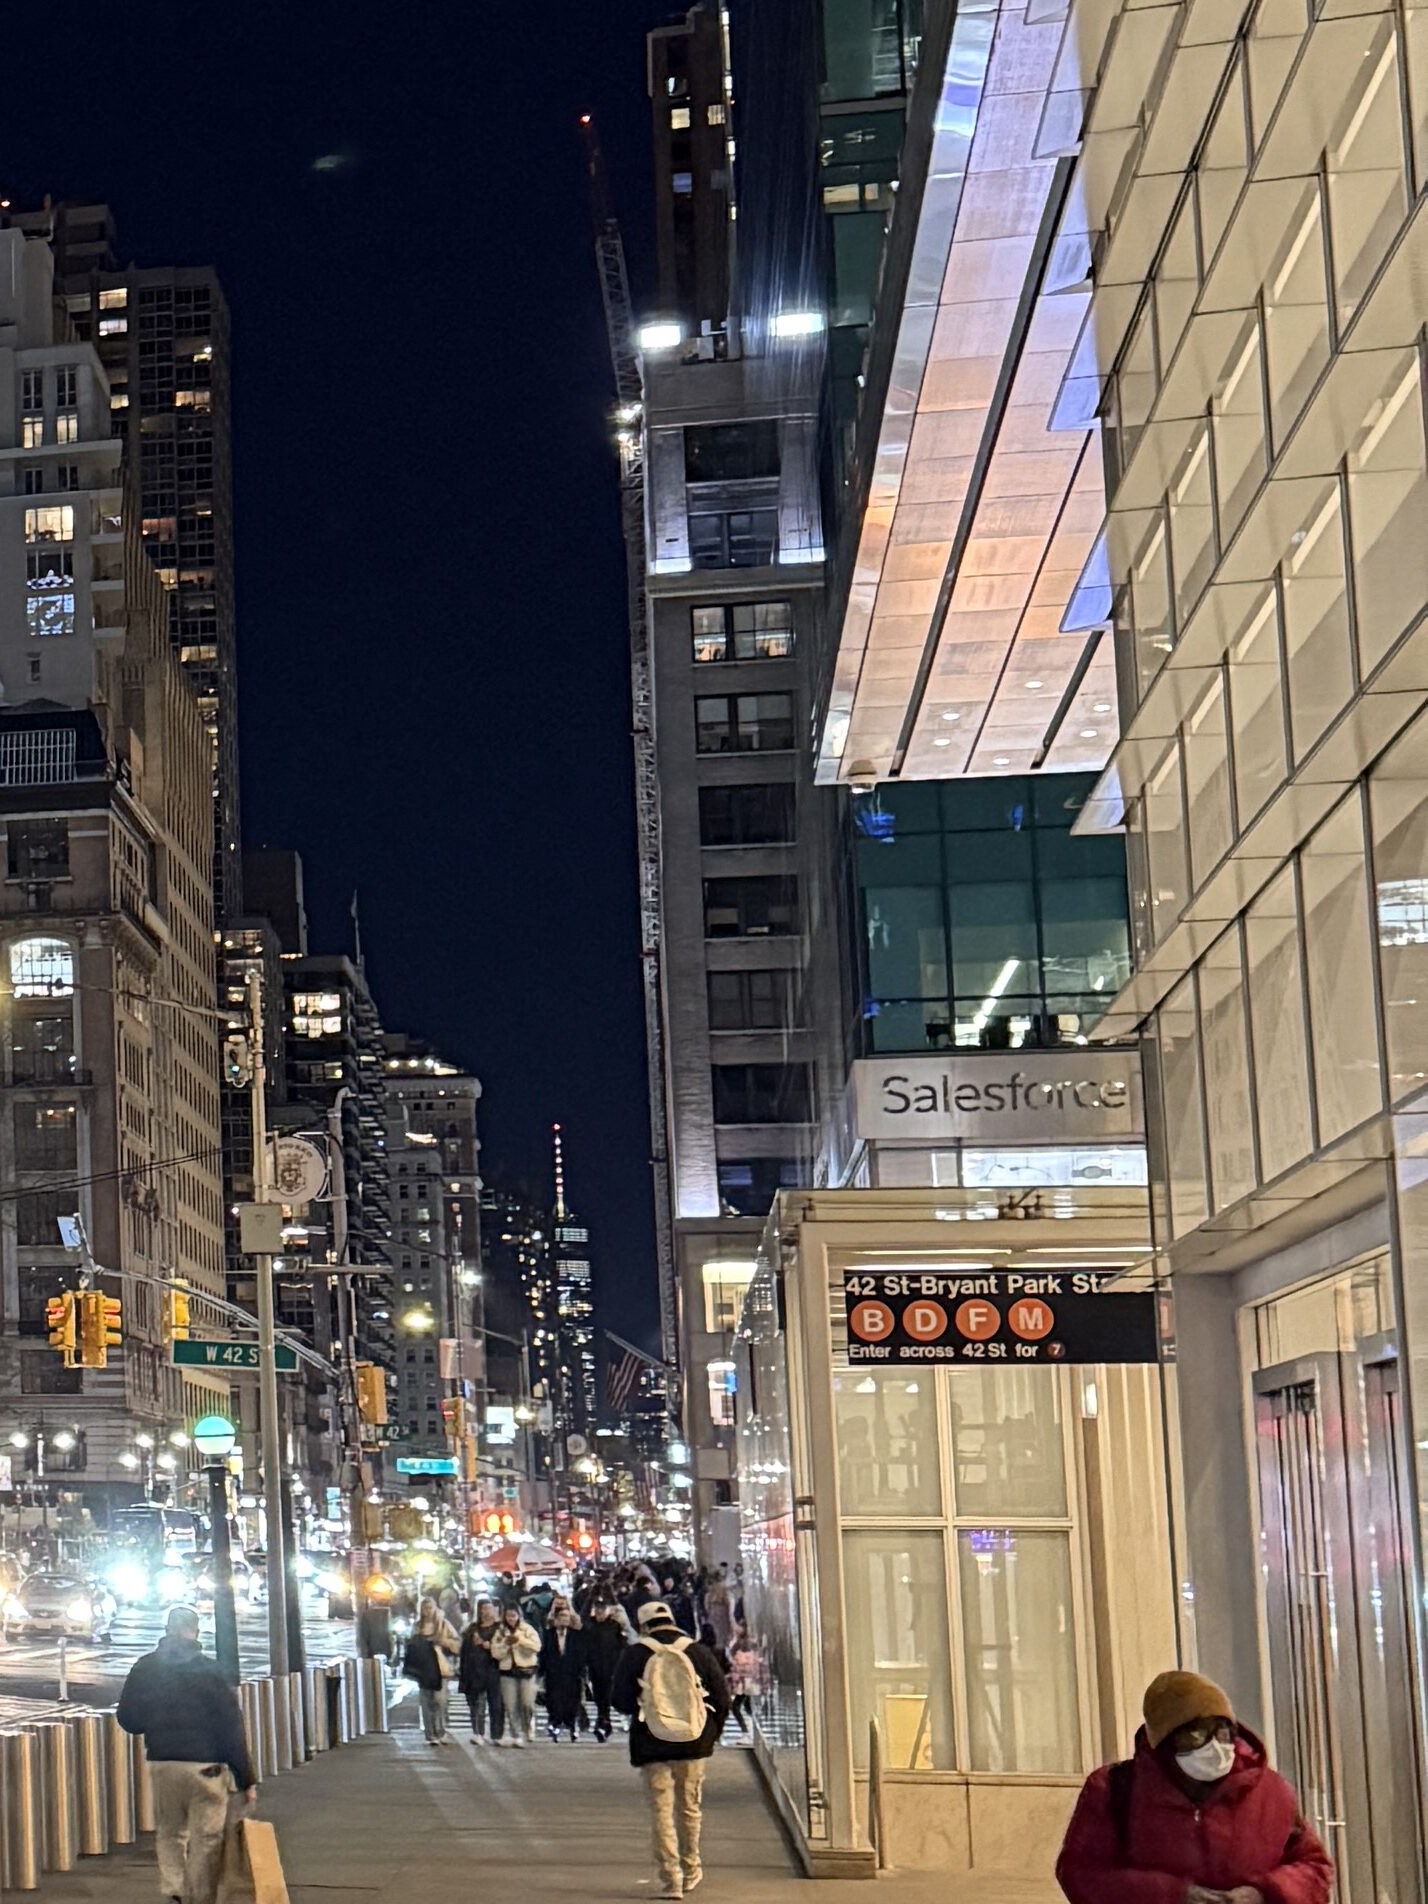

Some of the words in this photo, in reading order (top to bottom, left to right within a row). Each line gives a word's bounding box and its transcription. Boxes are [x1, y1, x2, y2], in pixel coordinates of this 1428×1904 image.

[882, 1072, 1127, 1114] Salesforce
[845, 1276, 876, 1296] 42
[884, 1275, 999, 1299] St-Bryant
[1007, 1274, 1062, 1294] Park
[862, 1309, 885, 1332] B
[914, 1308, 938, 1332] D
[968, 1307, 988, 1332] F
[1018, 1307, 1043, 1330] M
[206, 1346, 219, 1363] W
[223, 1346, 243, 1363] 42
[248, 1347, 259, 1364] S
[849, 1344, 891, 1358] Enter
[899, 1346, 955, 1358] across
[962, 1343, 986, 1357] 42
[1015, 1343, 1038, 1357] for
[1051, 1344, 1061, 1355] 7
[386, 1425, 400, 1440] 42
